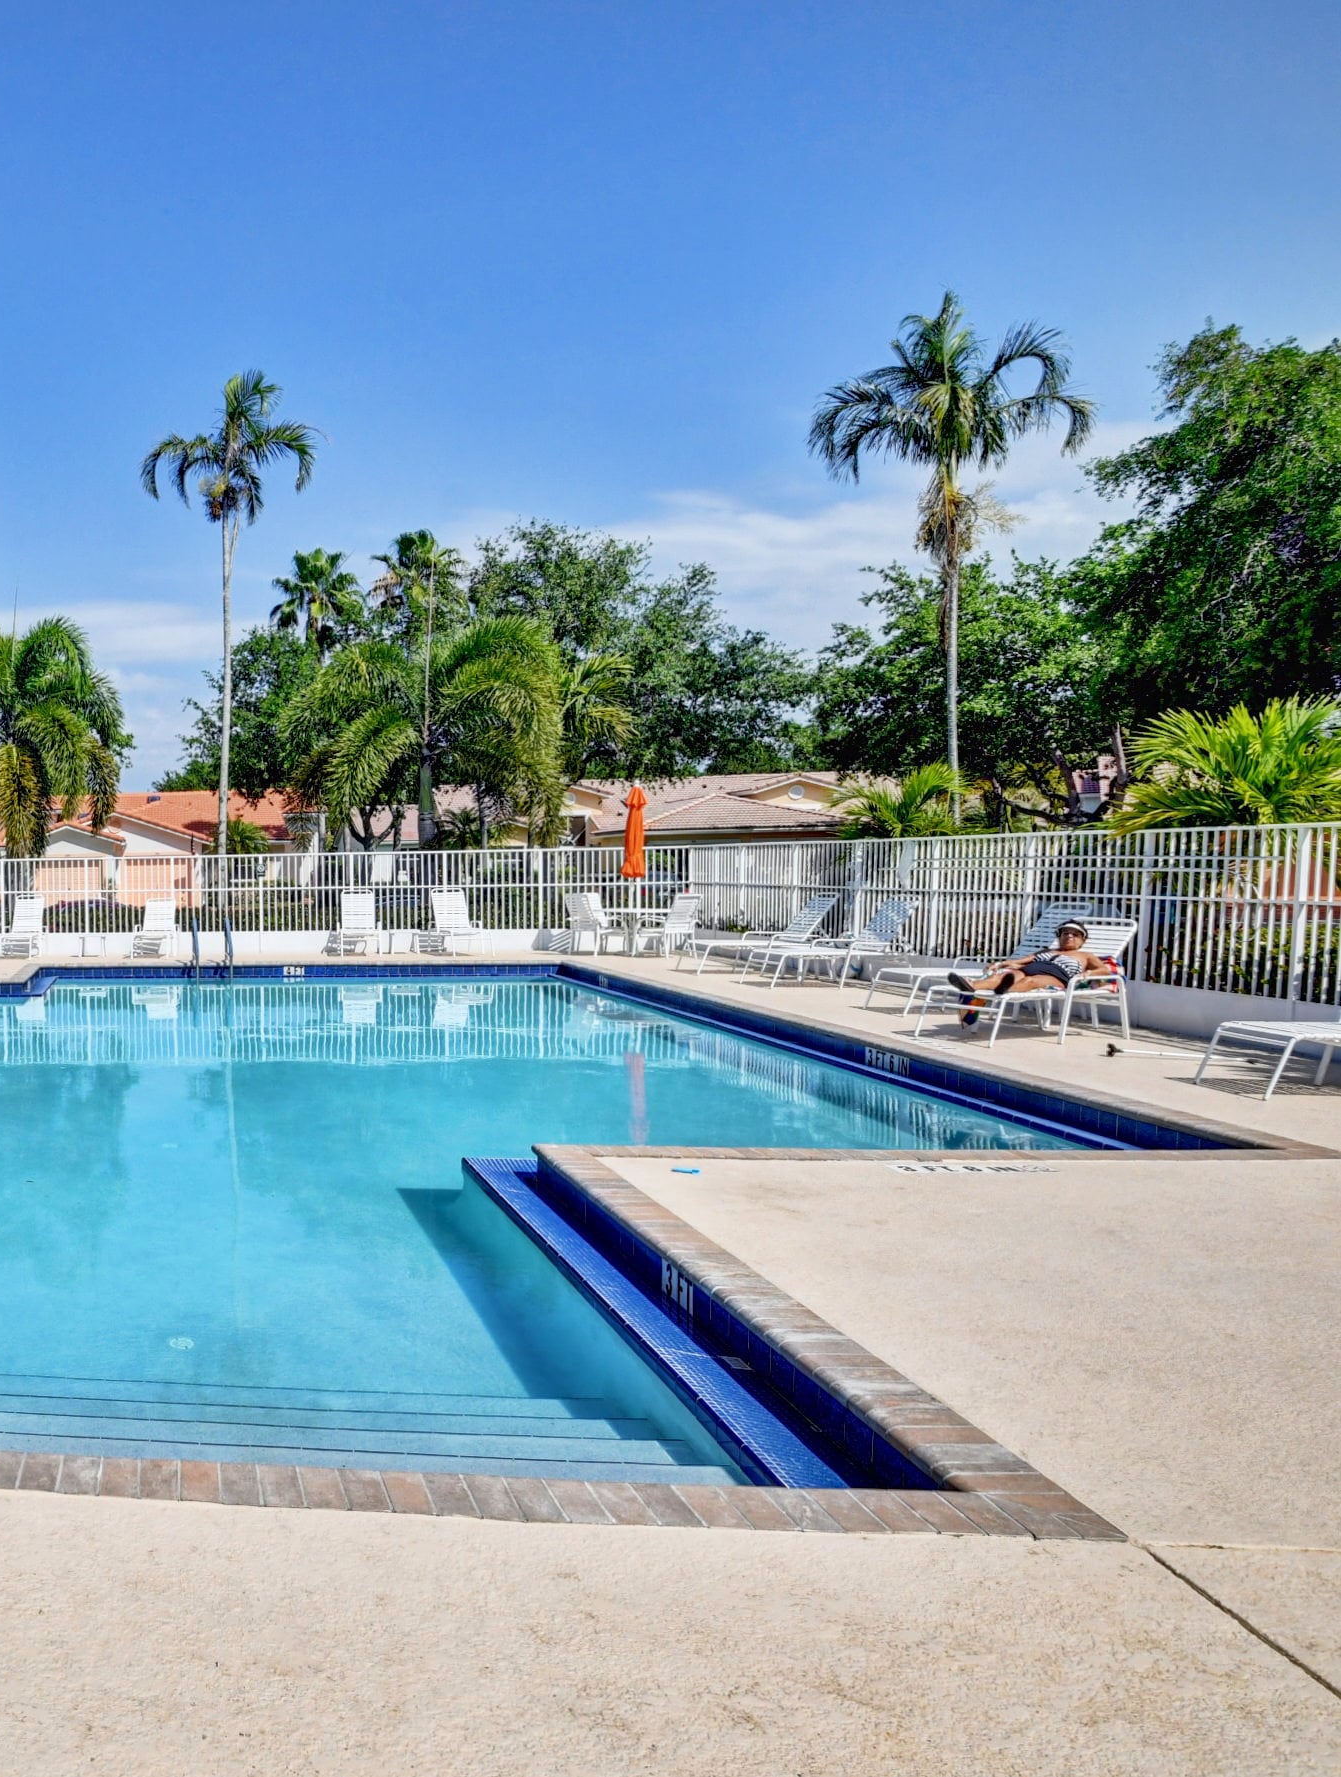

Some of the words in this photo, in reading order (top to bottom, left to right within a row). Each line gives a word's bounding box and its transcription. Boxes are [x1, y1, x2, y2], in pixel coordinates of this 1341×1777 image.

[867, 1048, 873, 1067] 3
[875, 1050, 886, 1071] FT
[889, 1054, 895, 1074] 6
[897, 1056, 909, 1078] IN
[665, 1263, 673, 1297] 3
[677, 1270, 693, 1314] FT
